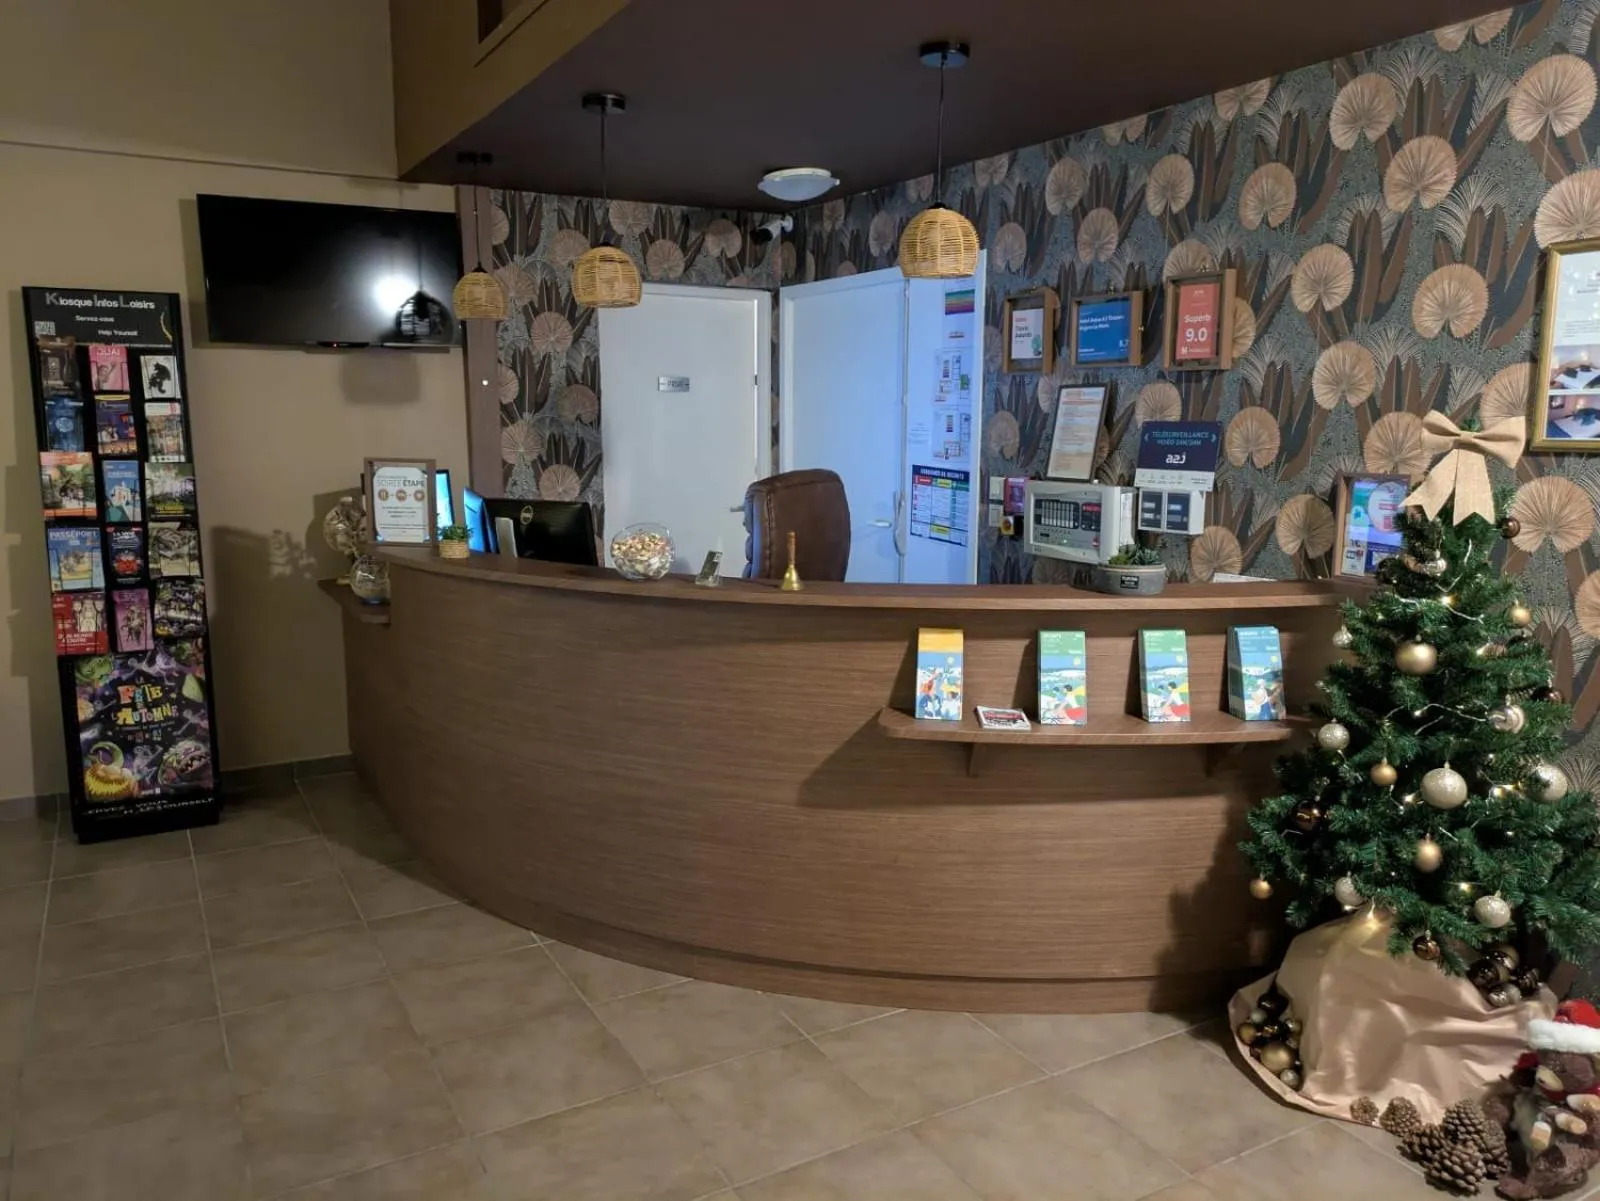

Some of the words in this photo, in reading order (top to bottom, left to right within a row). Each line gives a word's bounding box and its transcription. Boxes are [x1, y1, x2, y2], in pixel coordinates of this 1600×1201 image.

[45, 292, 93, 309] Kiosque
[93, 294, 119, 308] Infos
[119, 295, 156, 309] Loisirs
[1185, 327, 1208, 342] 9.0
[49, 530, 97, 541] PASSEPORT
